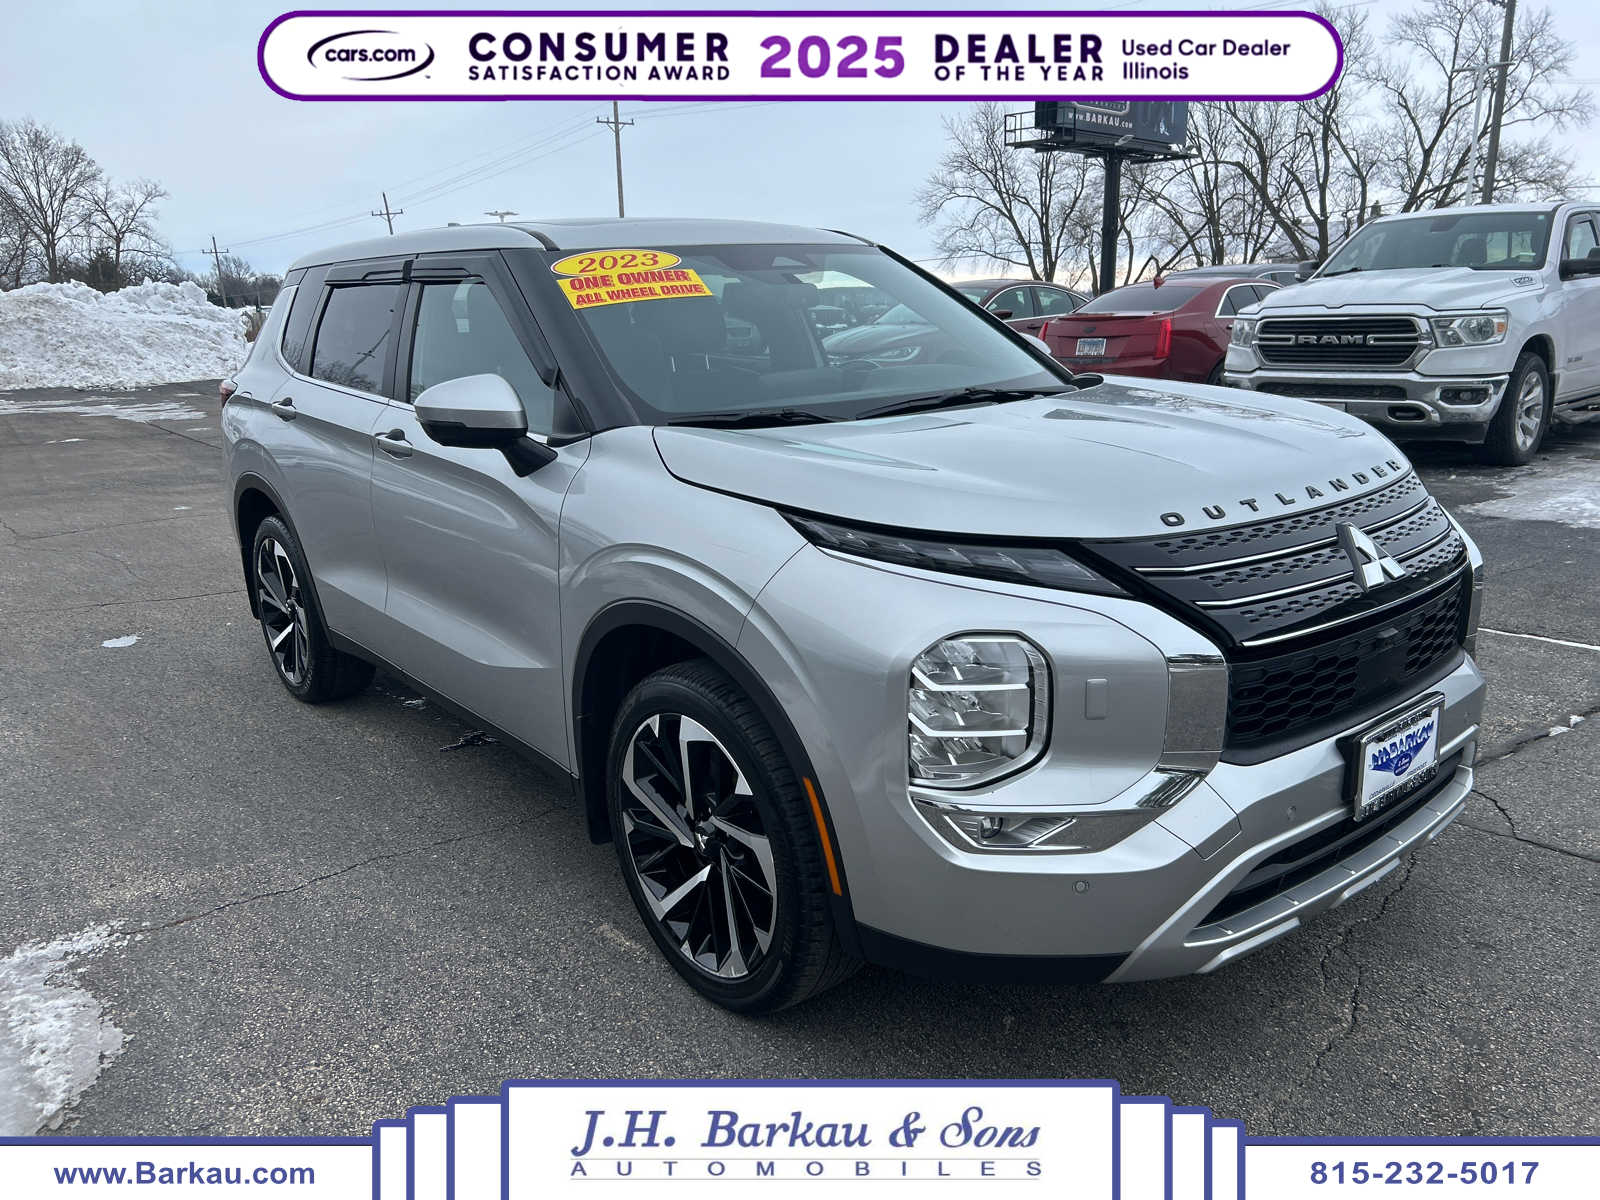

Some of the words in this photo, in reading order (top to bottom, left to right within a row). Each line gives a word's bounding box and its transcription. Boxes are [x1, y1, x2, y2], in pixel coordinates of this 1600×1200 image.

[578, 253, 660, 273] 2023
[569, 274, 615, 291] ONE
[616, 269, 692, 286] OWNER
[575, 291, 607, 306] ALL
[606, 286, 660, 301] WHEEL
[660, 283, 706, 296] DRIVE
[1297, 334, 1364, 345] RAM
[1159, 459, 1402, 527] OUTLANDER
